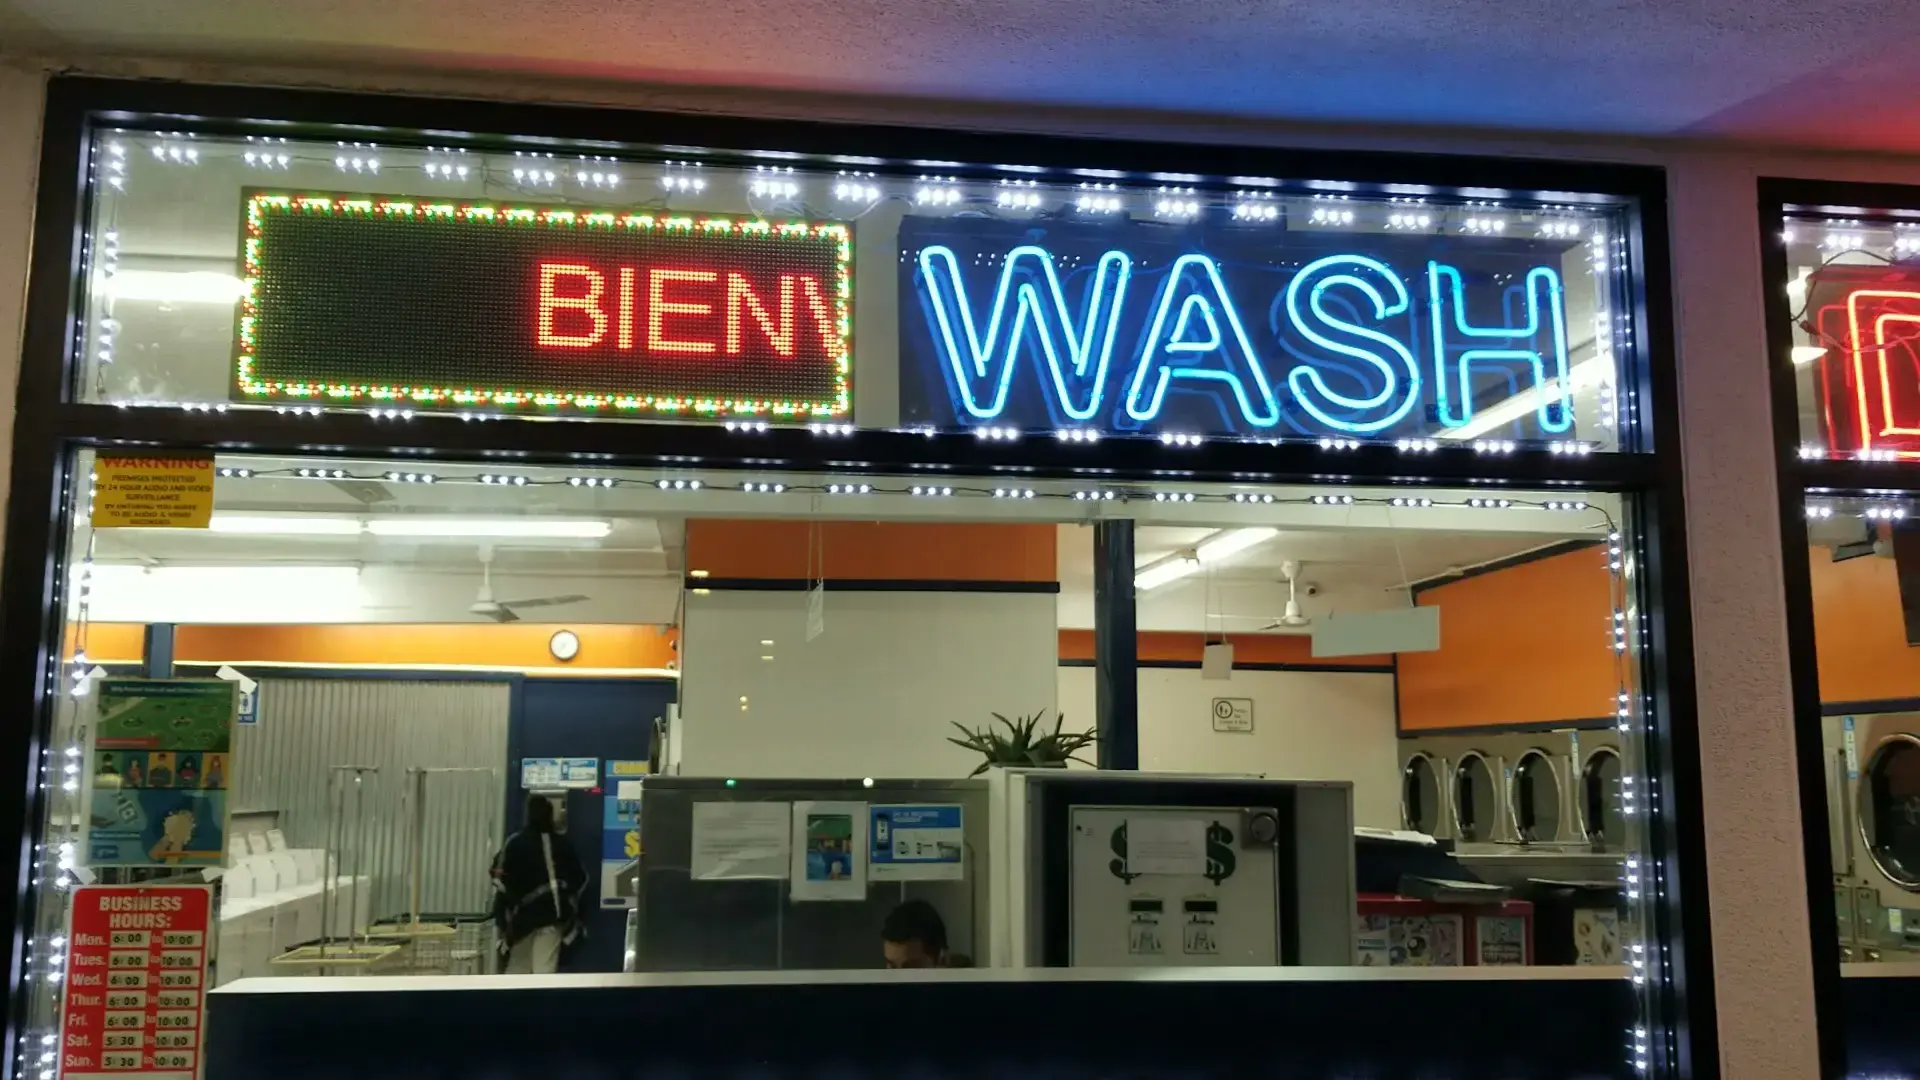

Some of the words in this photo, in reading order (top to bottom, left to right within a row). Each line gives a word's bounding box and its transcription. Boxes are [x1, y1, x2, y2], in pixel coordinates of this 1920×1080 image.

[918, 245, 1573, 433] WASH
[99, 896, 182, 911] BUSINESS
[109, 913, 172, 928] HOURS:
[75, 932, 107, 945] Mon.
[73, 953, 106, 966] Tues.
[71, 973, 104, 986] Wed.
[70, 993, 102, 1006] Thur.
[68, 1013, 89, 1026] Fri.
[66, 1033, 92, 1047] Sat.
[65, 1054, 95, 1067] Sun.
